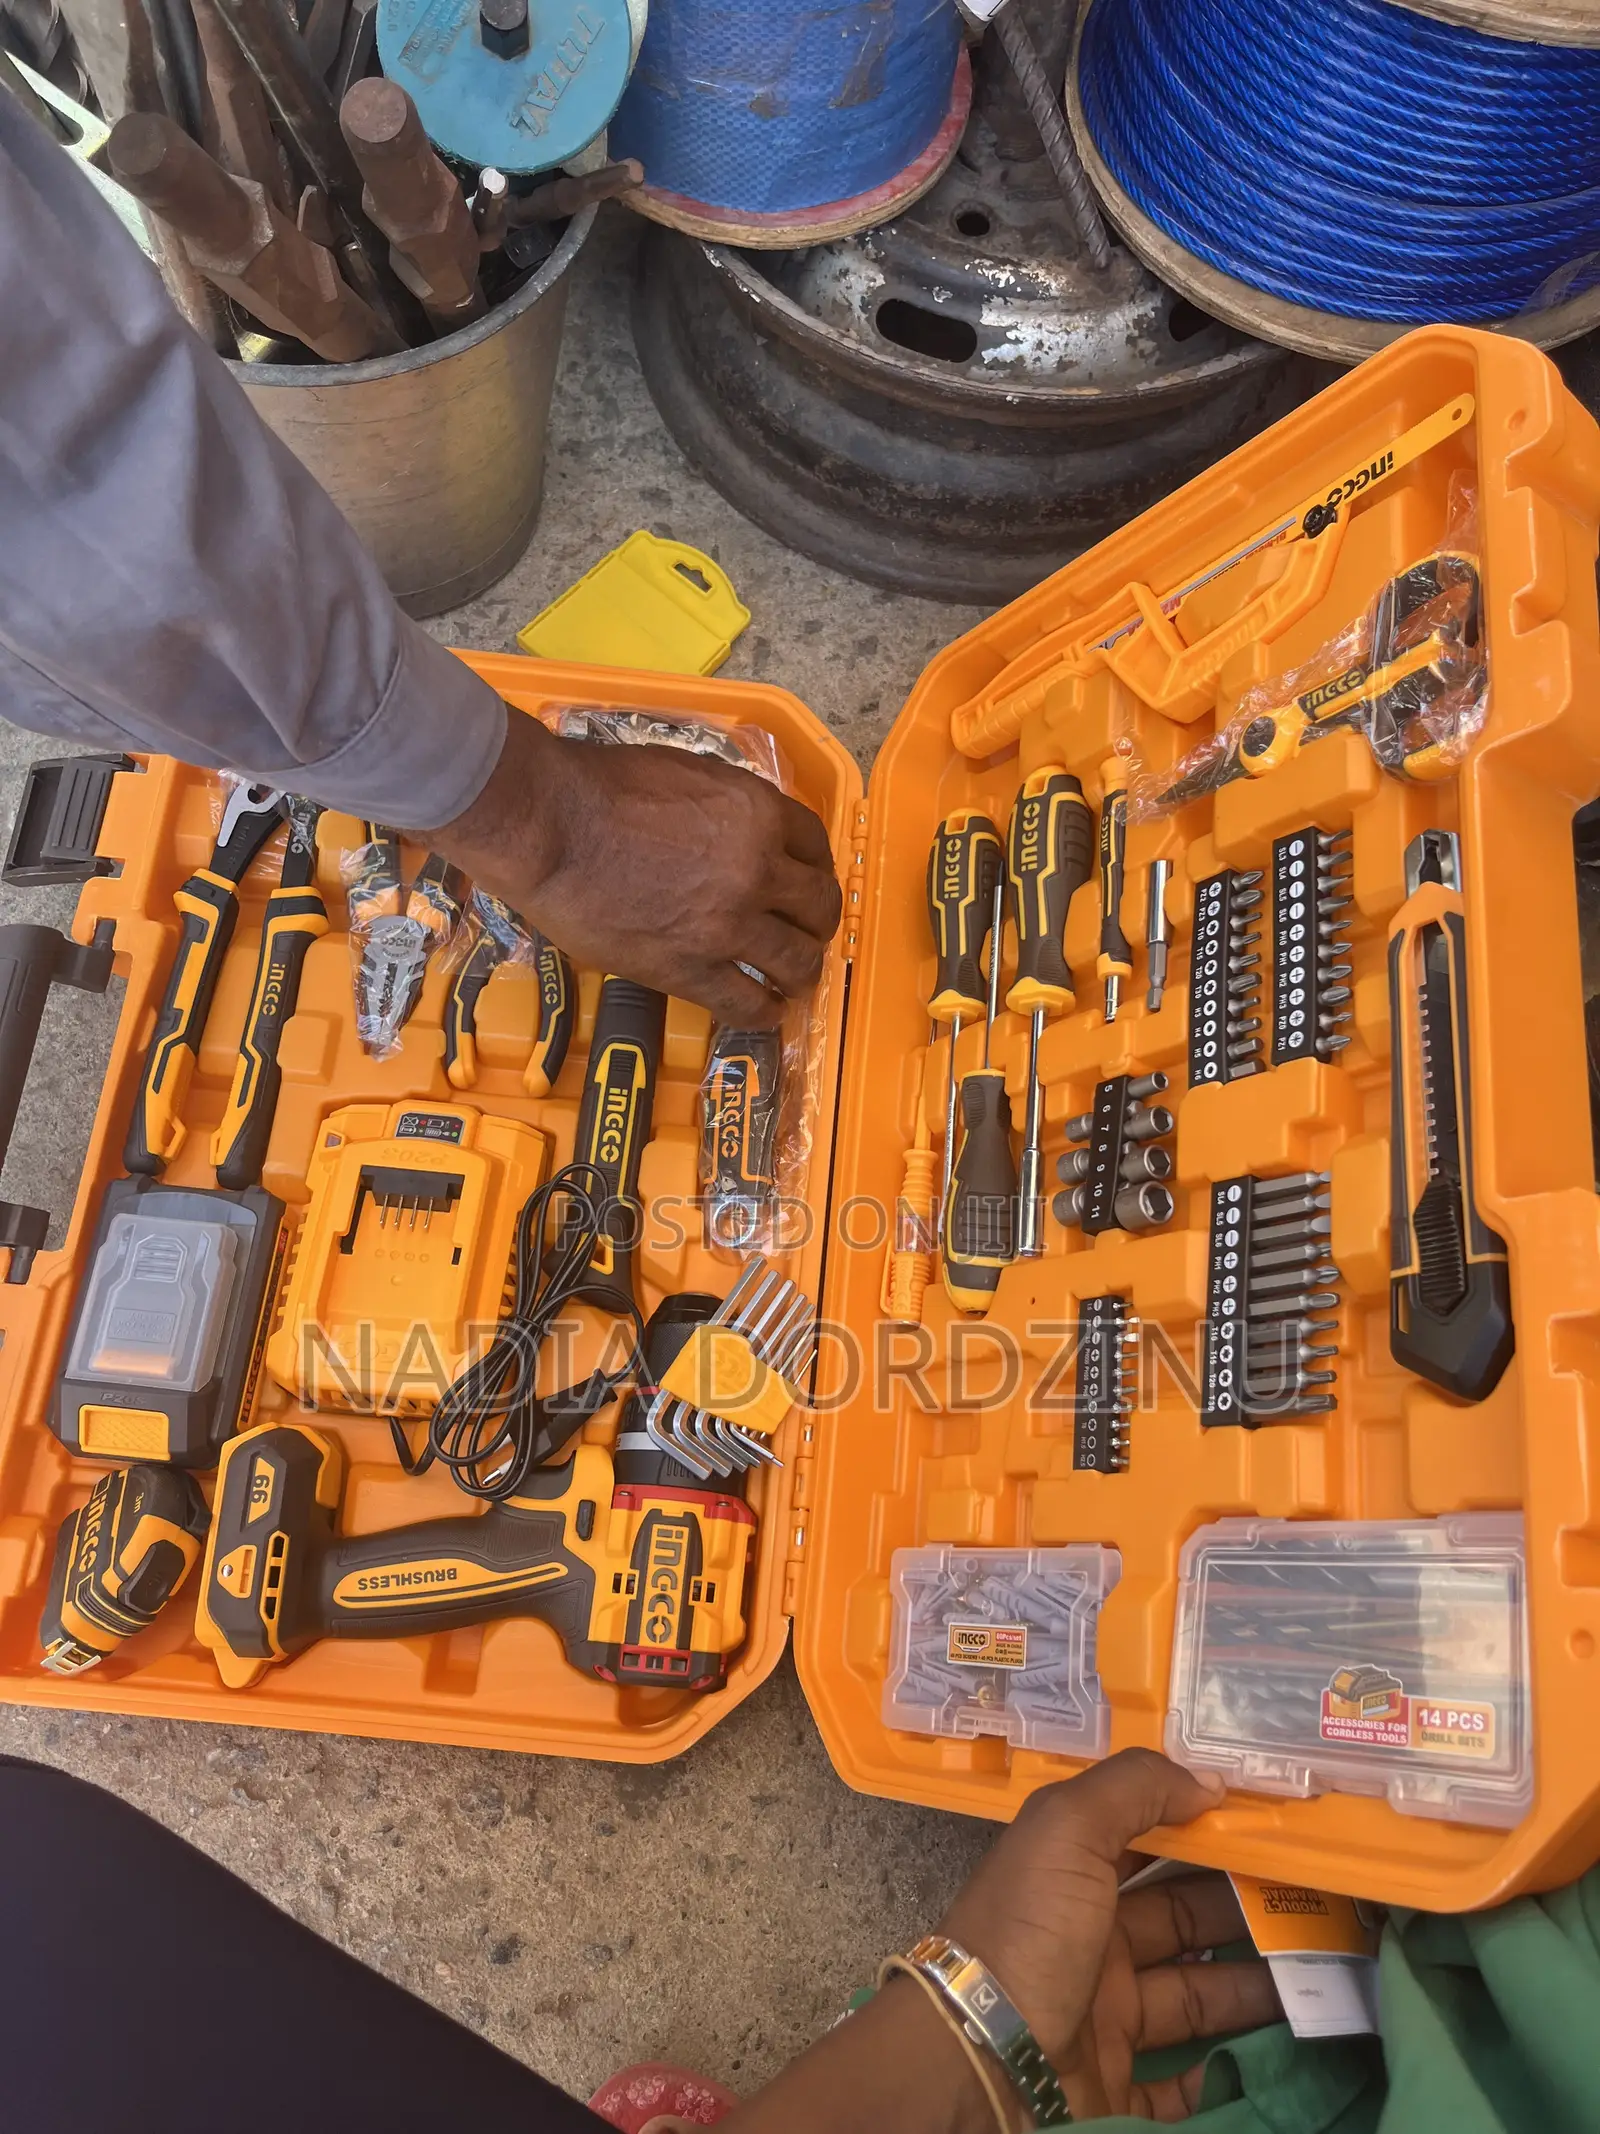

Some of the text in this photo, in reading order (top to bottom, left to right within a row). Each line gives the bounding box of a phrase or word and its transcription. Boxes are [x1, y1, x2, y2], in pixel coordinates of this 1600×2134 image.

[1104, 1084, 1113, 1092] 5
[1102, 1104, 1111, 1113] 6
[1101, 1124, 1110, 1132] 7
[1098, 1144, 1107, 1152] 8
[1096, 1163, 1105, 1172] 9
[1094, 1182, 1103, 1197] 10
[1090, 1204, 1101, 1218] 11
[251, 1475, 270, 1504] 66
[357, 1567, 457, 1592] BRUSHLESS
[1322, 1715, 1408, 1733] ACCESSORIES FOR
[1419, 1709, 1484, 1731] 14 PCS
[1326, 1727, 1407, 1744] CORDLESS TOOLS
[1264, 1900, 1330, 1916] PRODUCT
